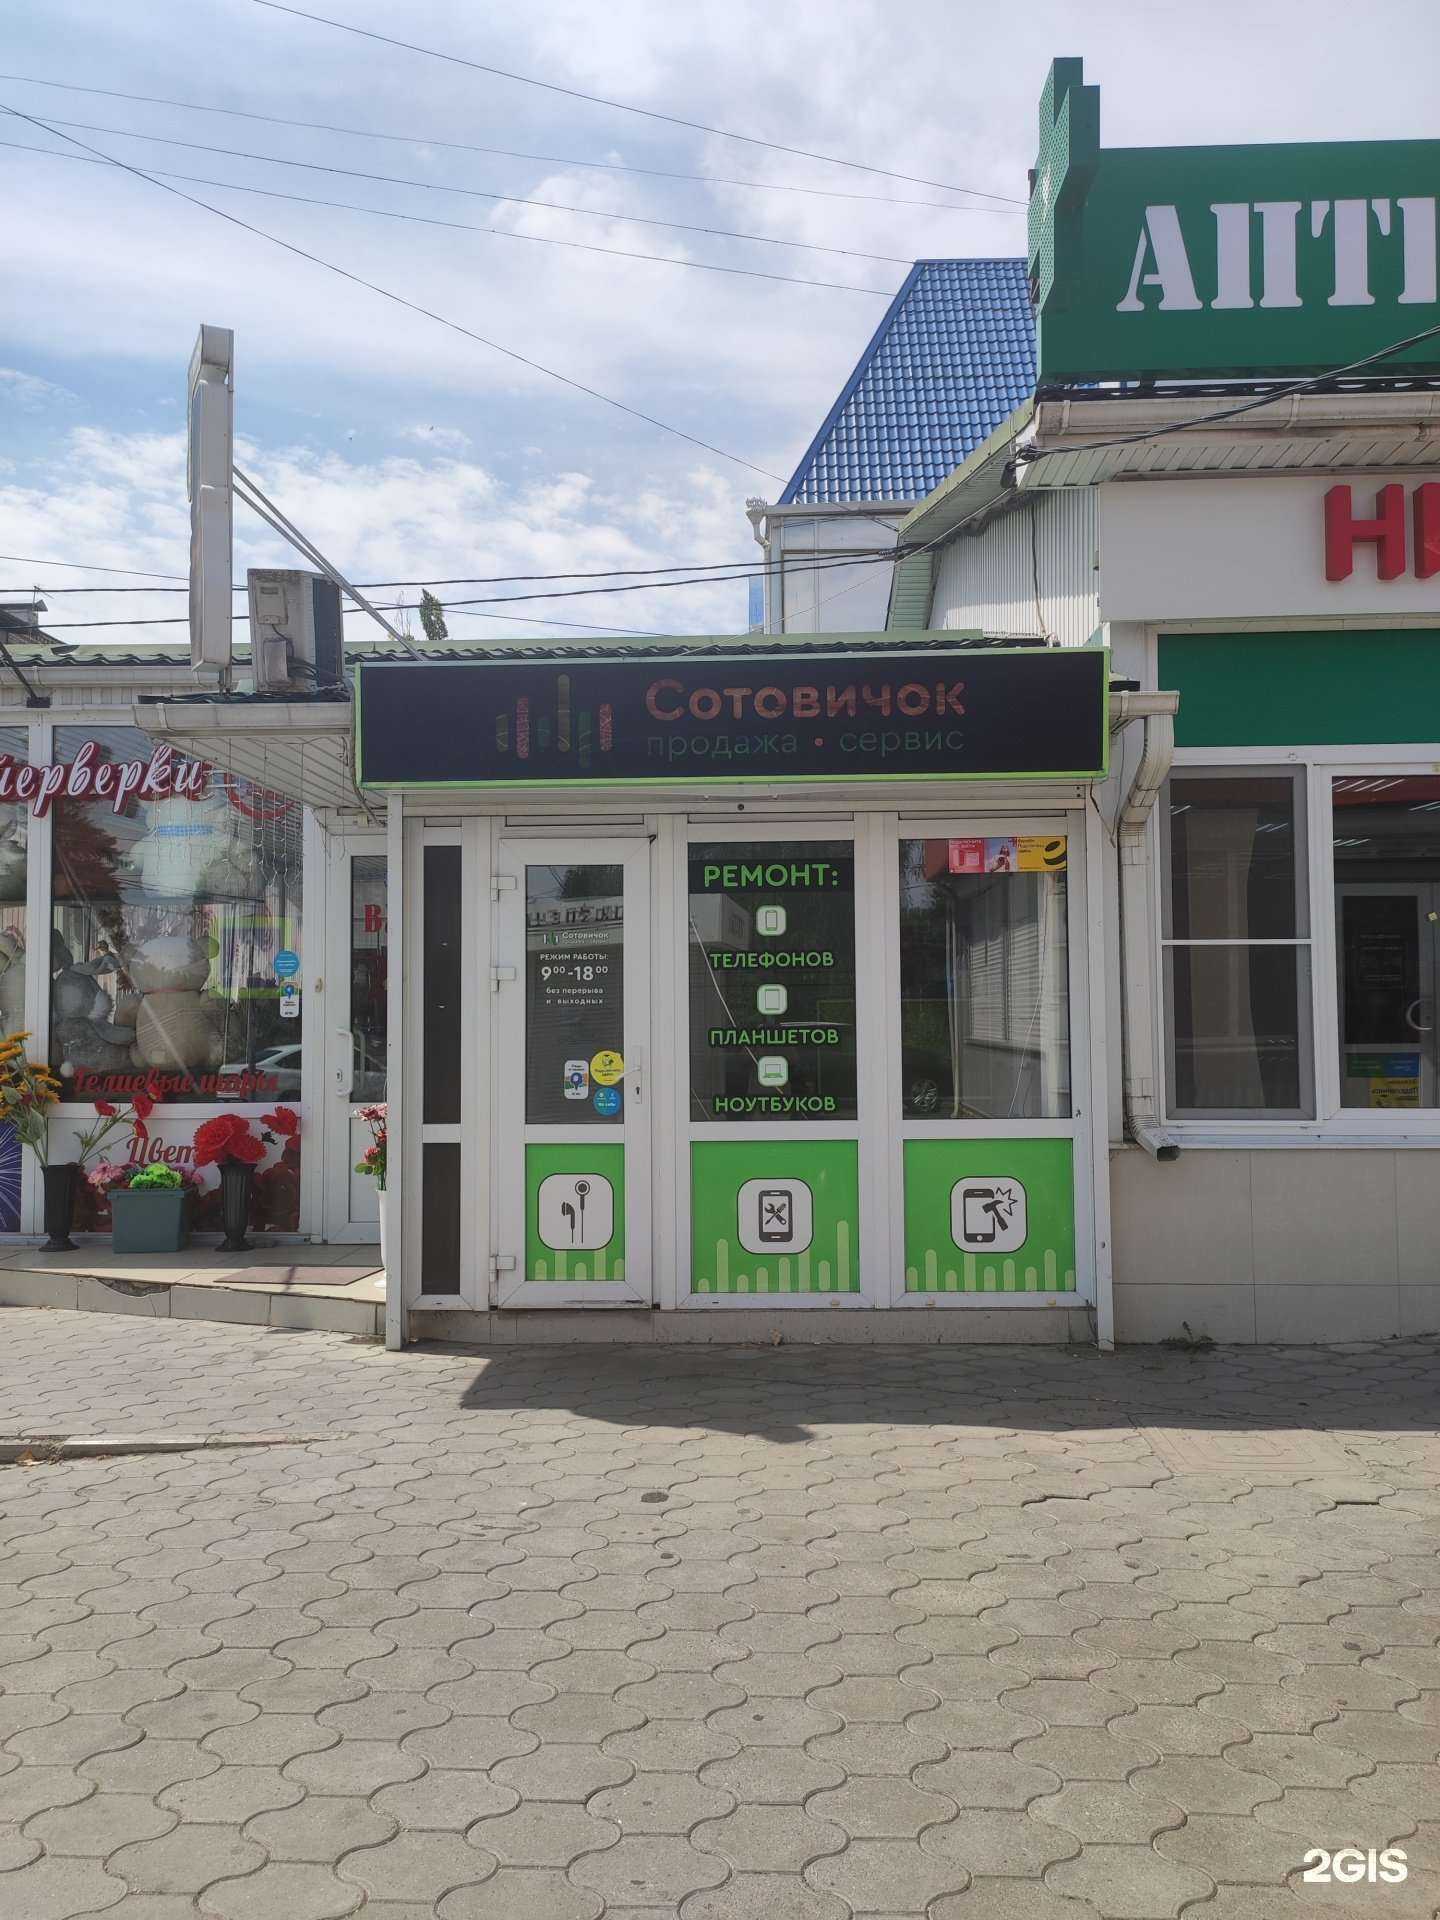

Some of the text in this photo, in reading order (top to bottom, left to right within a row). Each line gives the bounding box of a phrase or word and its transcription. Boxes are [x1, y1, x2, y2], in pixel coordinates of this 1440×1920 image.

[646, 728, 966, 762] продажа сервис
[703, 863, 839, 888] РЕМОНТ:
[540, 952, 609, 961] РЕЖИМ РАБОТЫ:
[709, 951, 834, 969] ТЕЛЕФОНОВ
[711, 1029, 839, 1046] ПЛАНШЕТОВ
[715, 1096, 836, 1112] НОУТБУКОВ
